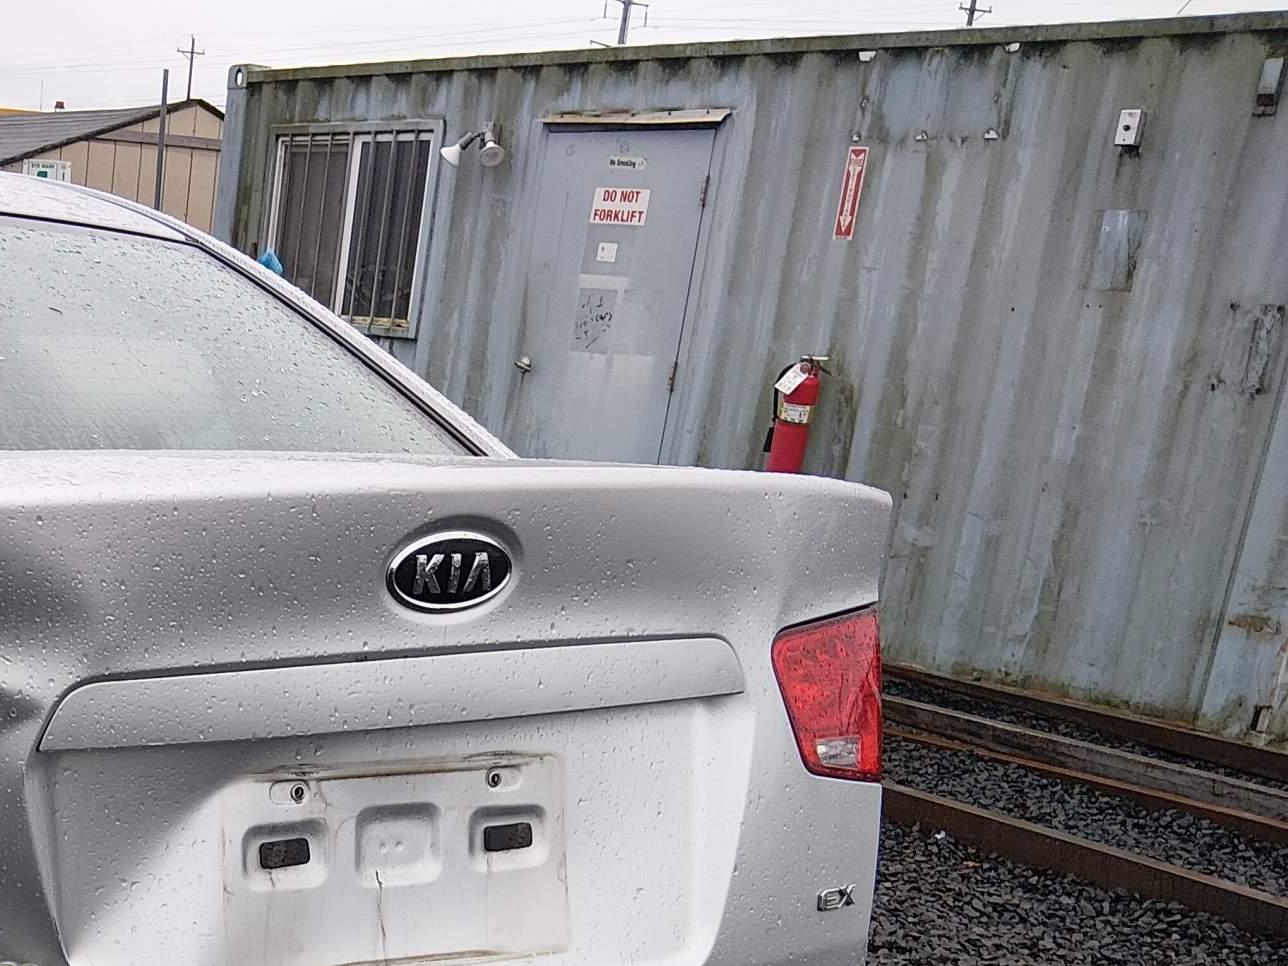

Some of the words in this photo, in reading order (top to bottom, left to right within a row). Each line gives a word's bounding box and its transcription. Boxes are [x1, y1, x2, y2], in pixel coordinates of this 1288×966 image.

[603, 190, 617, 202] DO
[619, 190, 641, 203] NOT
[593, 208, 644, 223] FORKLIFT
[413, 551, 492, 595] KIA
[816, 883, 857, 912] EX
